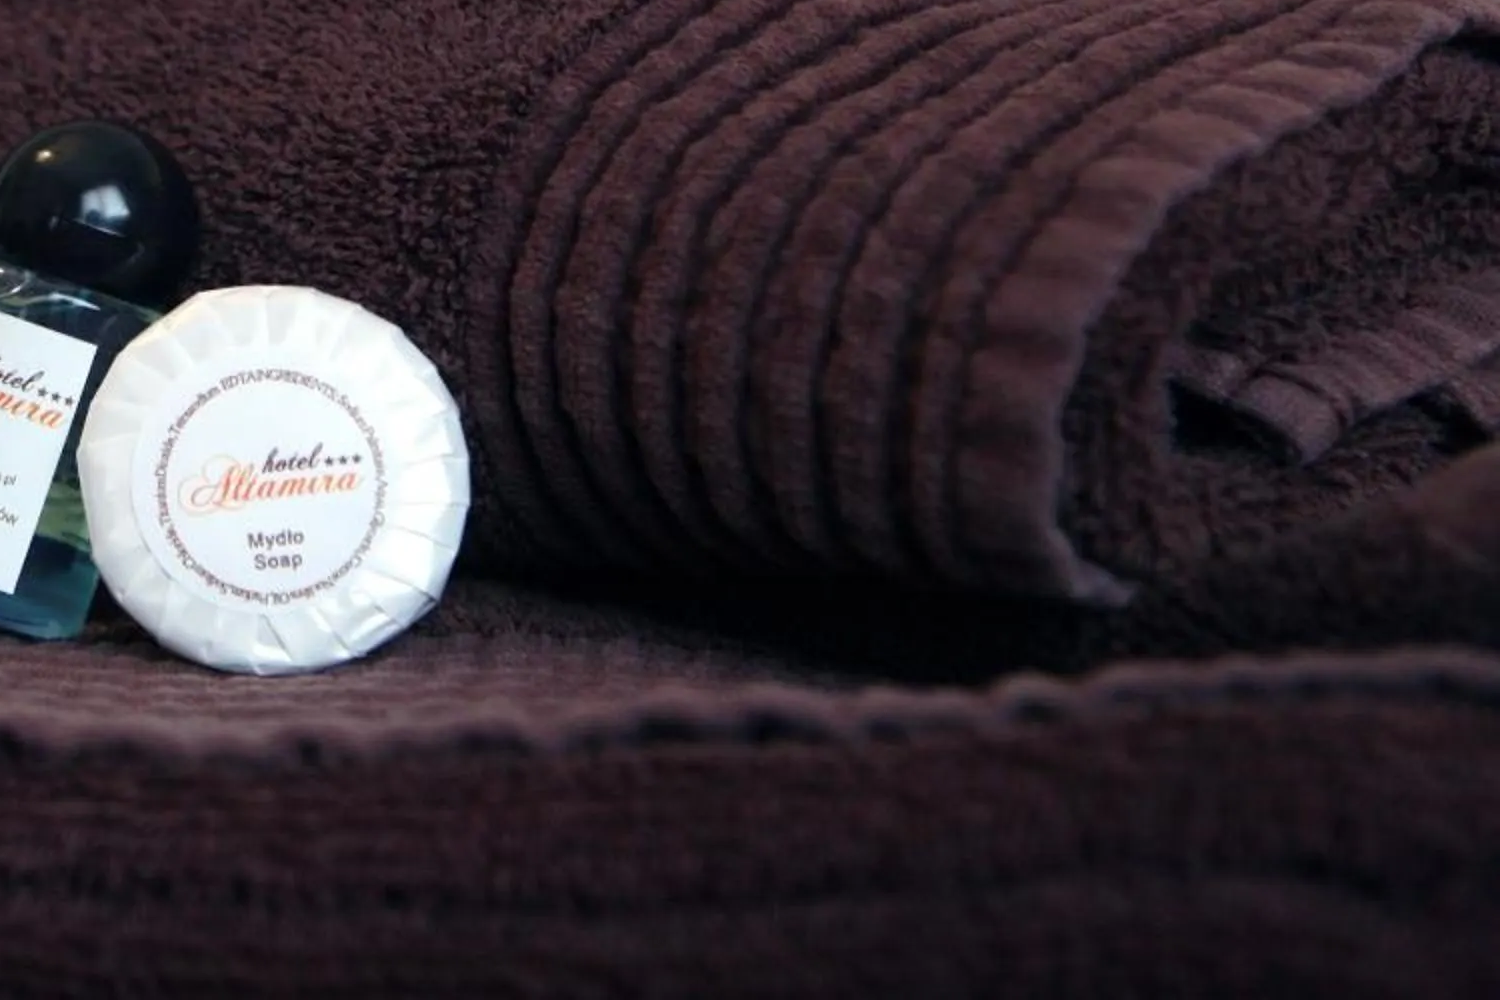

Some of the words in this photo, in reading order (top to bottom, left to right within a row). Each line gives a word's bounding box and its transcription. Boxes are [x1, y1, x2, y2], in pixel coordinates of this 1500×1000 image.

[262, 442, 324, 474] hotel
[178, 454, 362, 515] Altamira
[247, 529, 304, 550] Mydło
[254, 554, 303, 571] Soap
